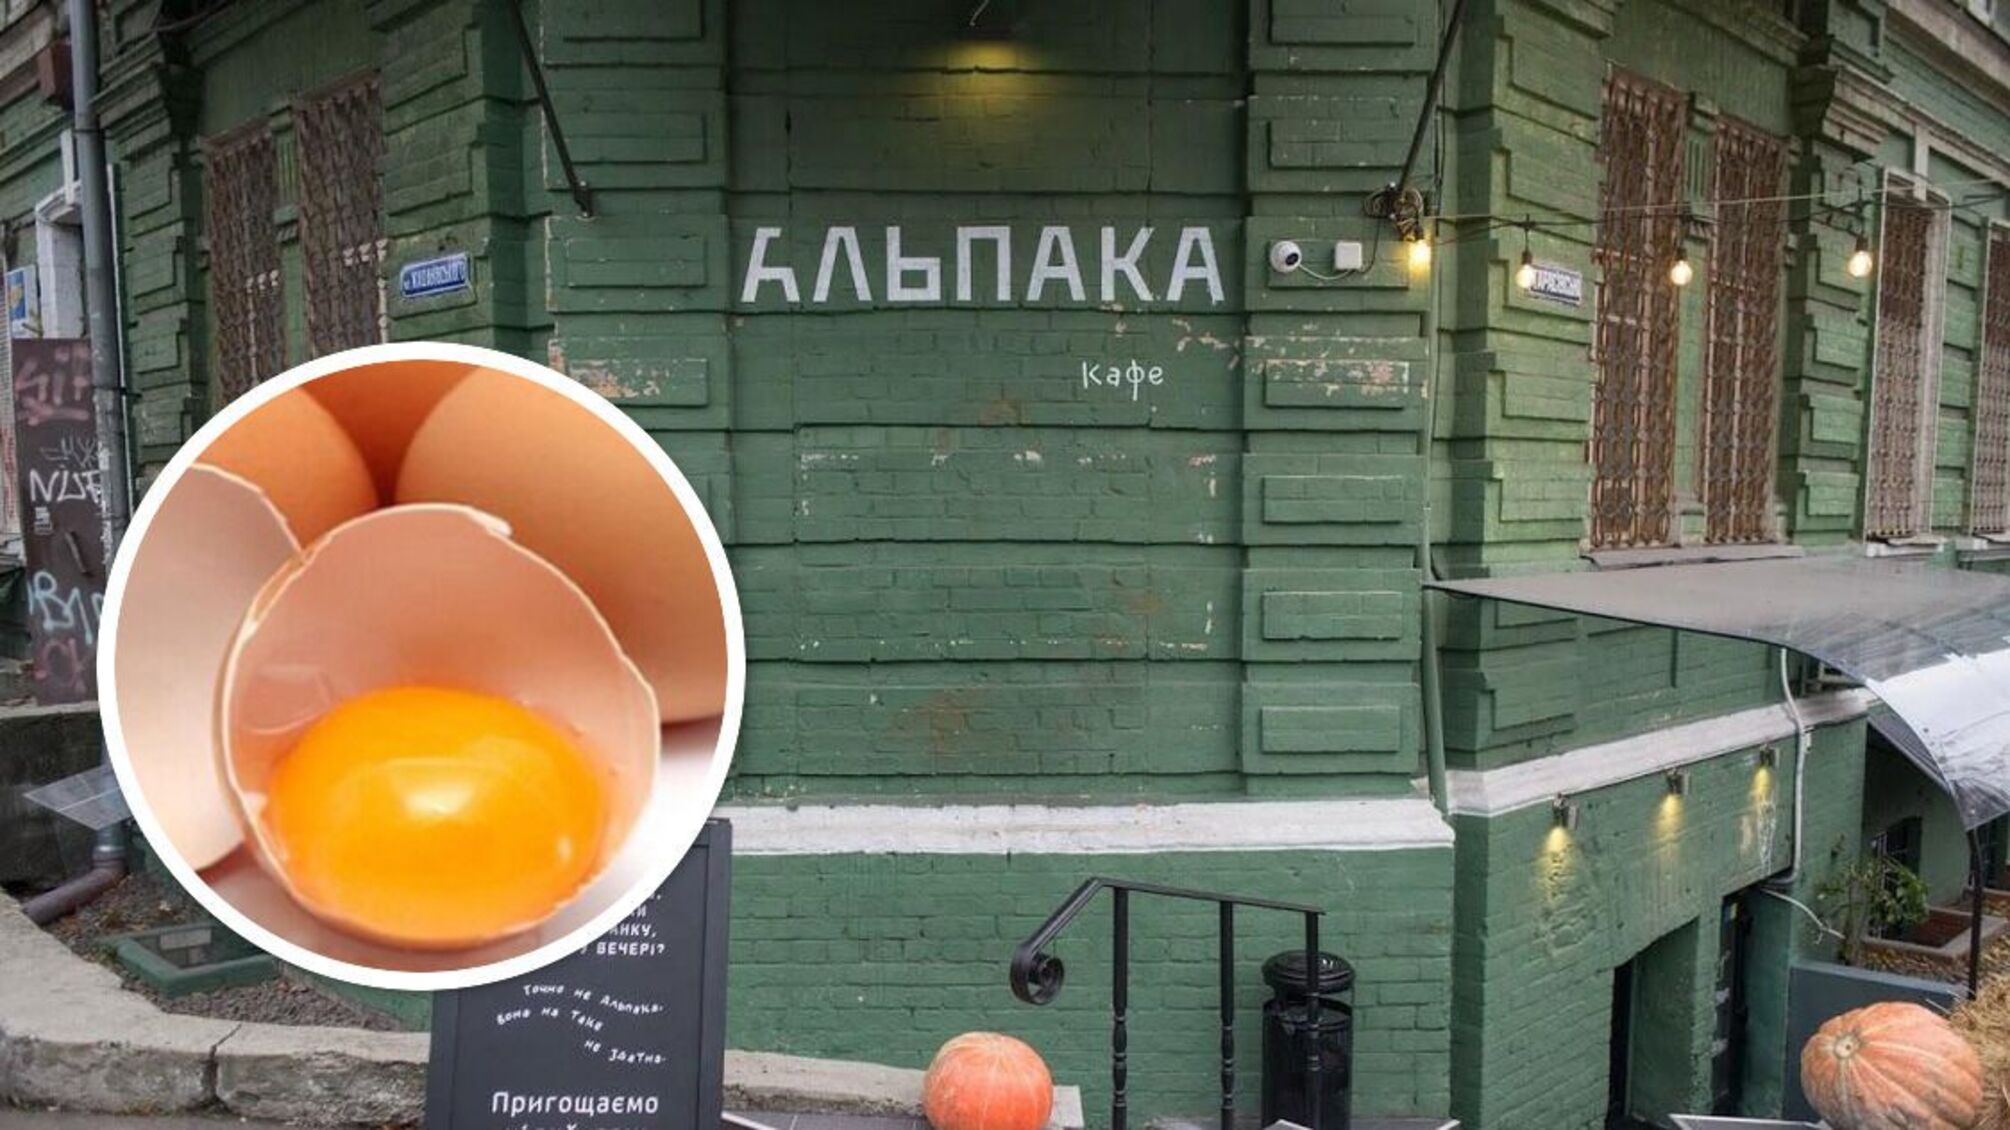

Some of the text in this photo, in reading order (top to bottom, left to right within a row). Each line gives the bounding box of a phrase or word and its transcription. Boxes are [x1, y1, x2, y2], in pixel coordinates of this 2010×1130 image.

[740, 226, 1225, 302] АЛЬПАКА
[1082, 359, 1164, 402] Кафе
[492, 1092, 659, 1118] Пригощаємо
